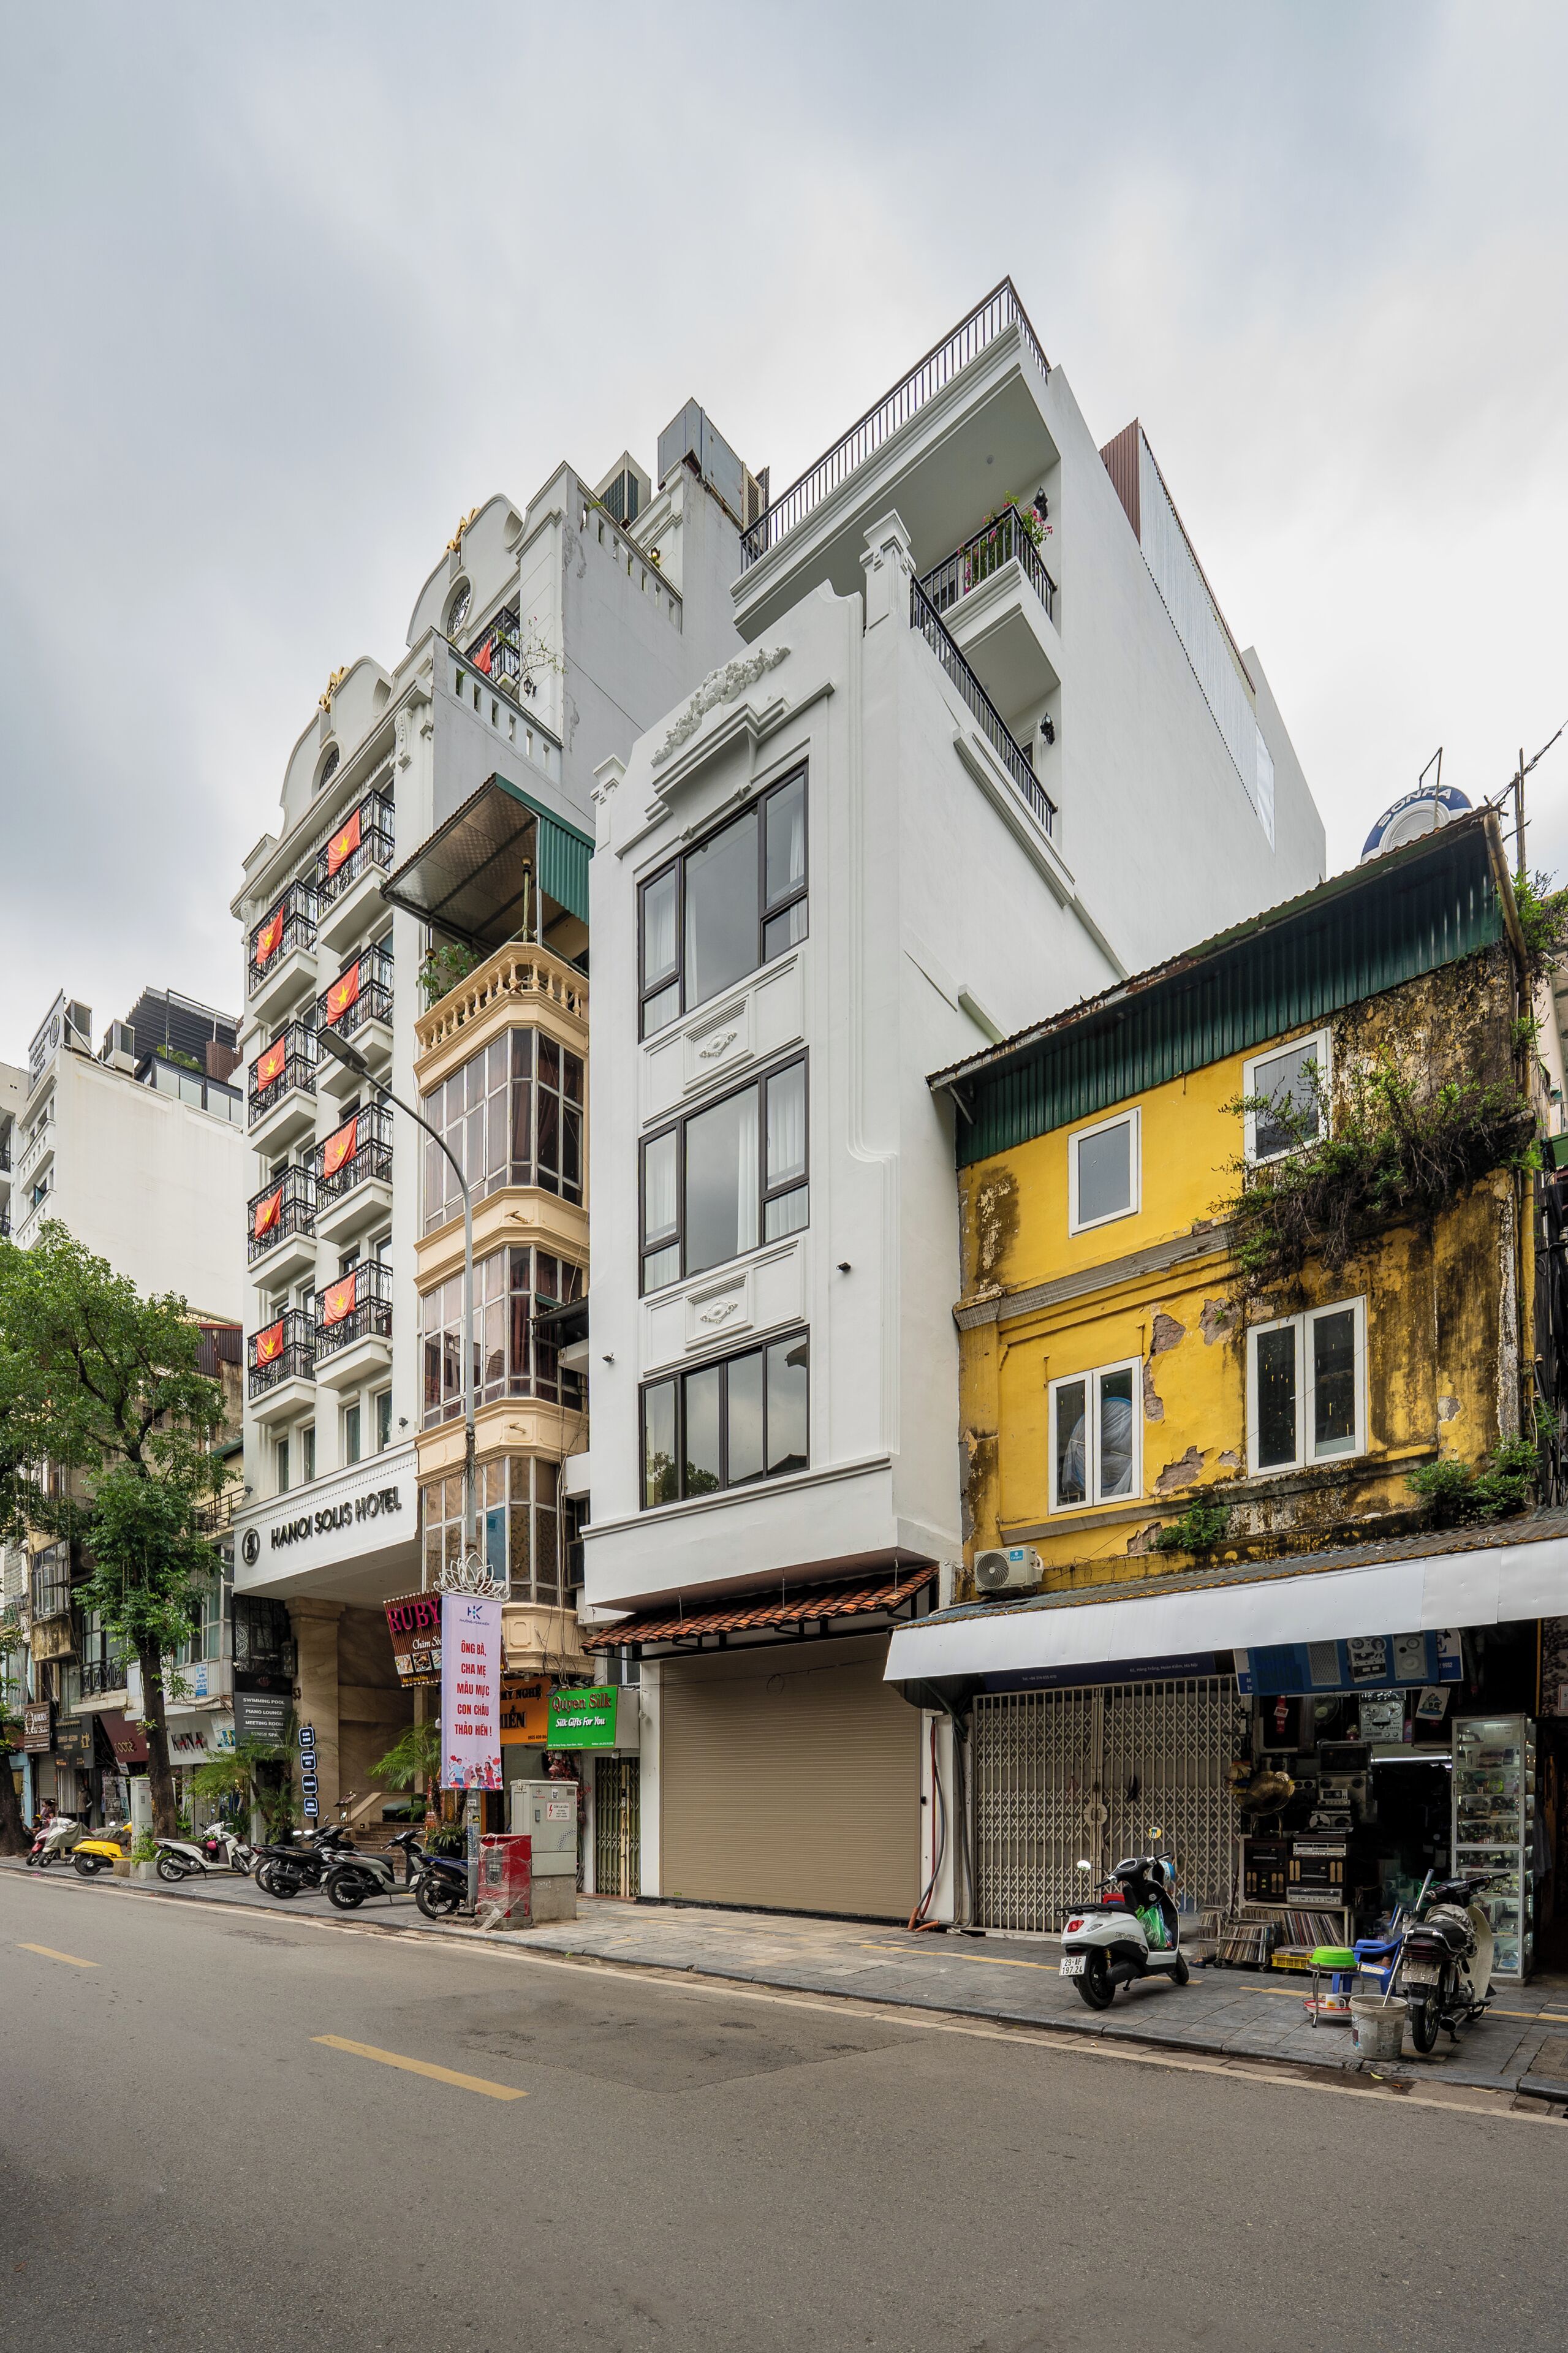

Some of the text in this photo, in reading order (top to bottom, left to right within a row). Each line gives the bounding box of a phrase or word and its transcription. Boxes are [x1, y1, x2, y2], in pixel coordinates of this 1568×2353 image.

[1377, 787, 1452, 828] SONHA
[271, 1515, 313, 1550] HANOI
[314, 1501, 353, 1534] SOLIS
[355, 1486, 402, 1522] HOTEL
[387, 1598, 442, 1633] RUBY
[412, 1637, 431, 1650] Chăm
[461, 1640, 487, 1656] ÔNG BÀ,
[461, 1663, 487, 1678] CHA MẸ
[456, 1681, 490, 1698] MẪU MỰC
[517, 1683, 542, 1700] NGHỆ
[457, 1703, 489, 1716] CON CHÁU
[552, 1692, 612, 1713] Quyen Silk
[455, 1721, 473, 1735] THẢO
[555, 1716, 605, 1728] Silk Gifts For You
[171, 1732, 204, 1751] KANA
[1064, 1958, 1082, 1966] 29-AF
